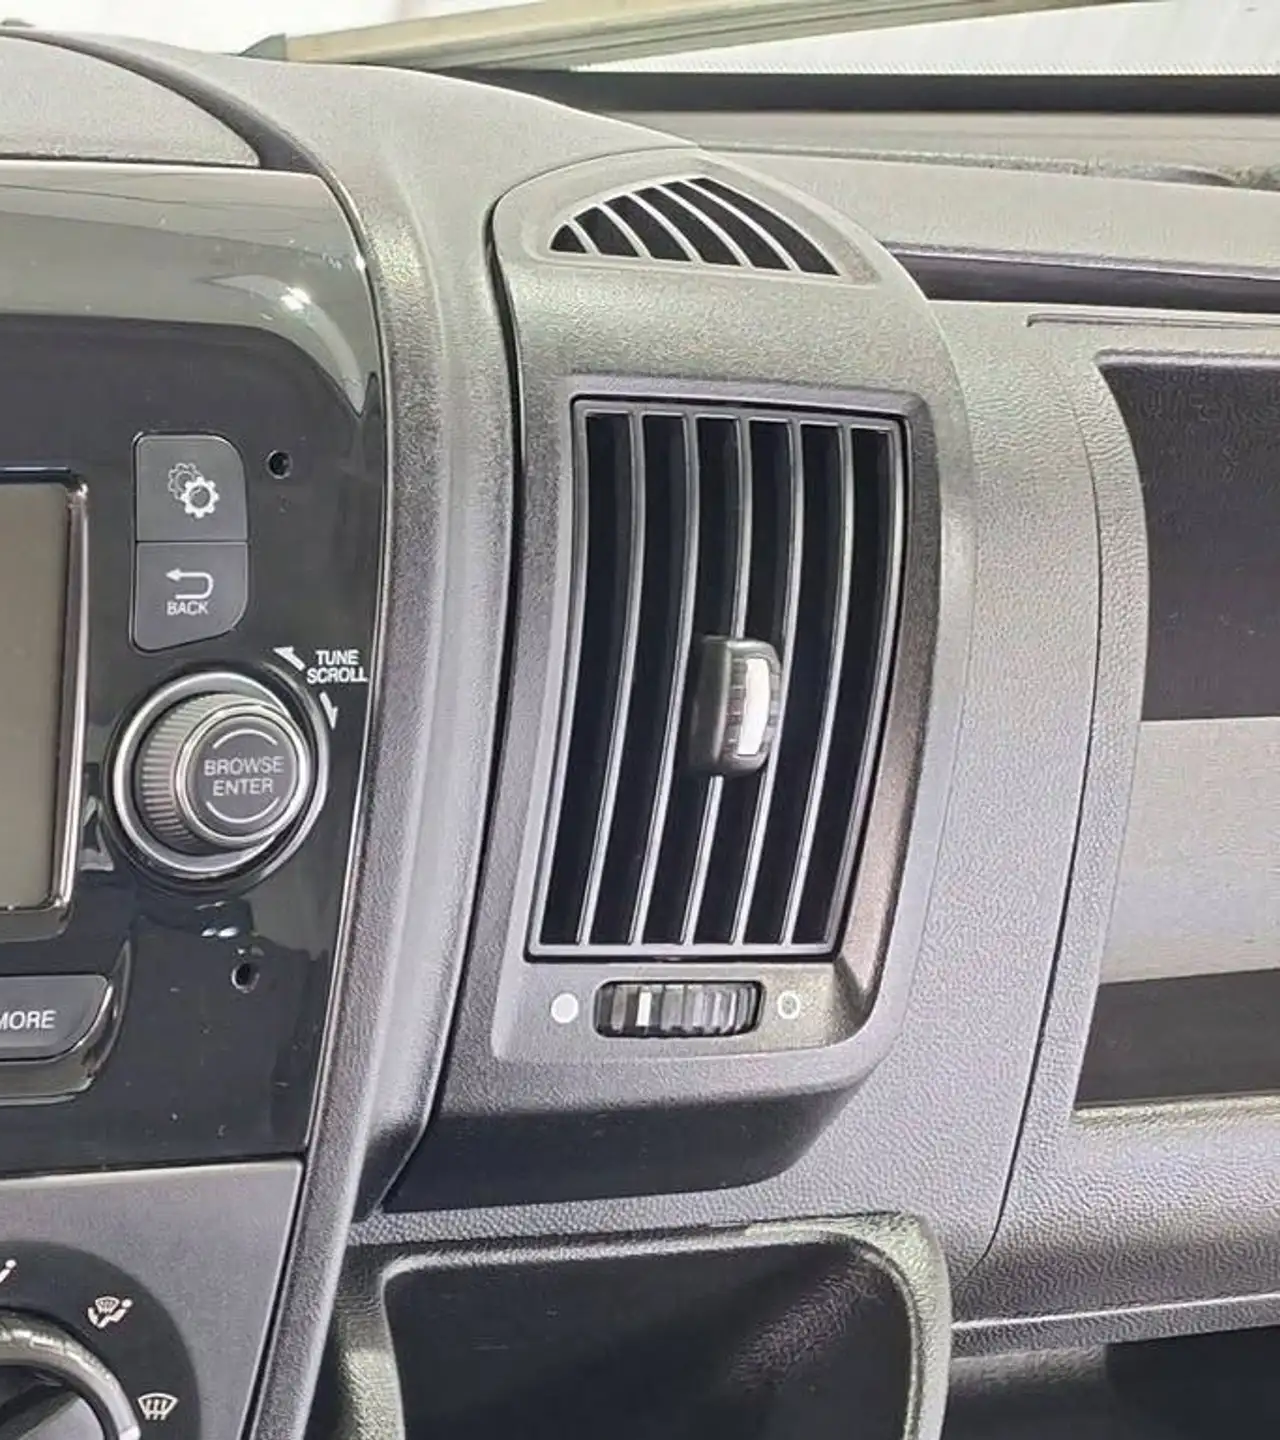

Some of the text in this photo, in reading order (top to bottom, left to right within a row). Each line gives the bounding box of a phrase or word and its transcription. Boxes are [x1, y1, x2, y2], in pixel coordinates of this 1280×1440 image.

[166, 600, 209, 616] BACK
[315, 649, 359, 666] TUNE
[306, 666, 369, 685] SCROLL
[204, 756, 285, 777] BROWSE
[212, 776, 274, 797] ENTER
